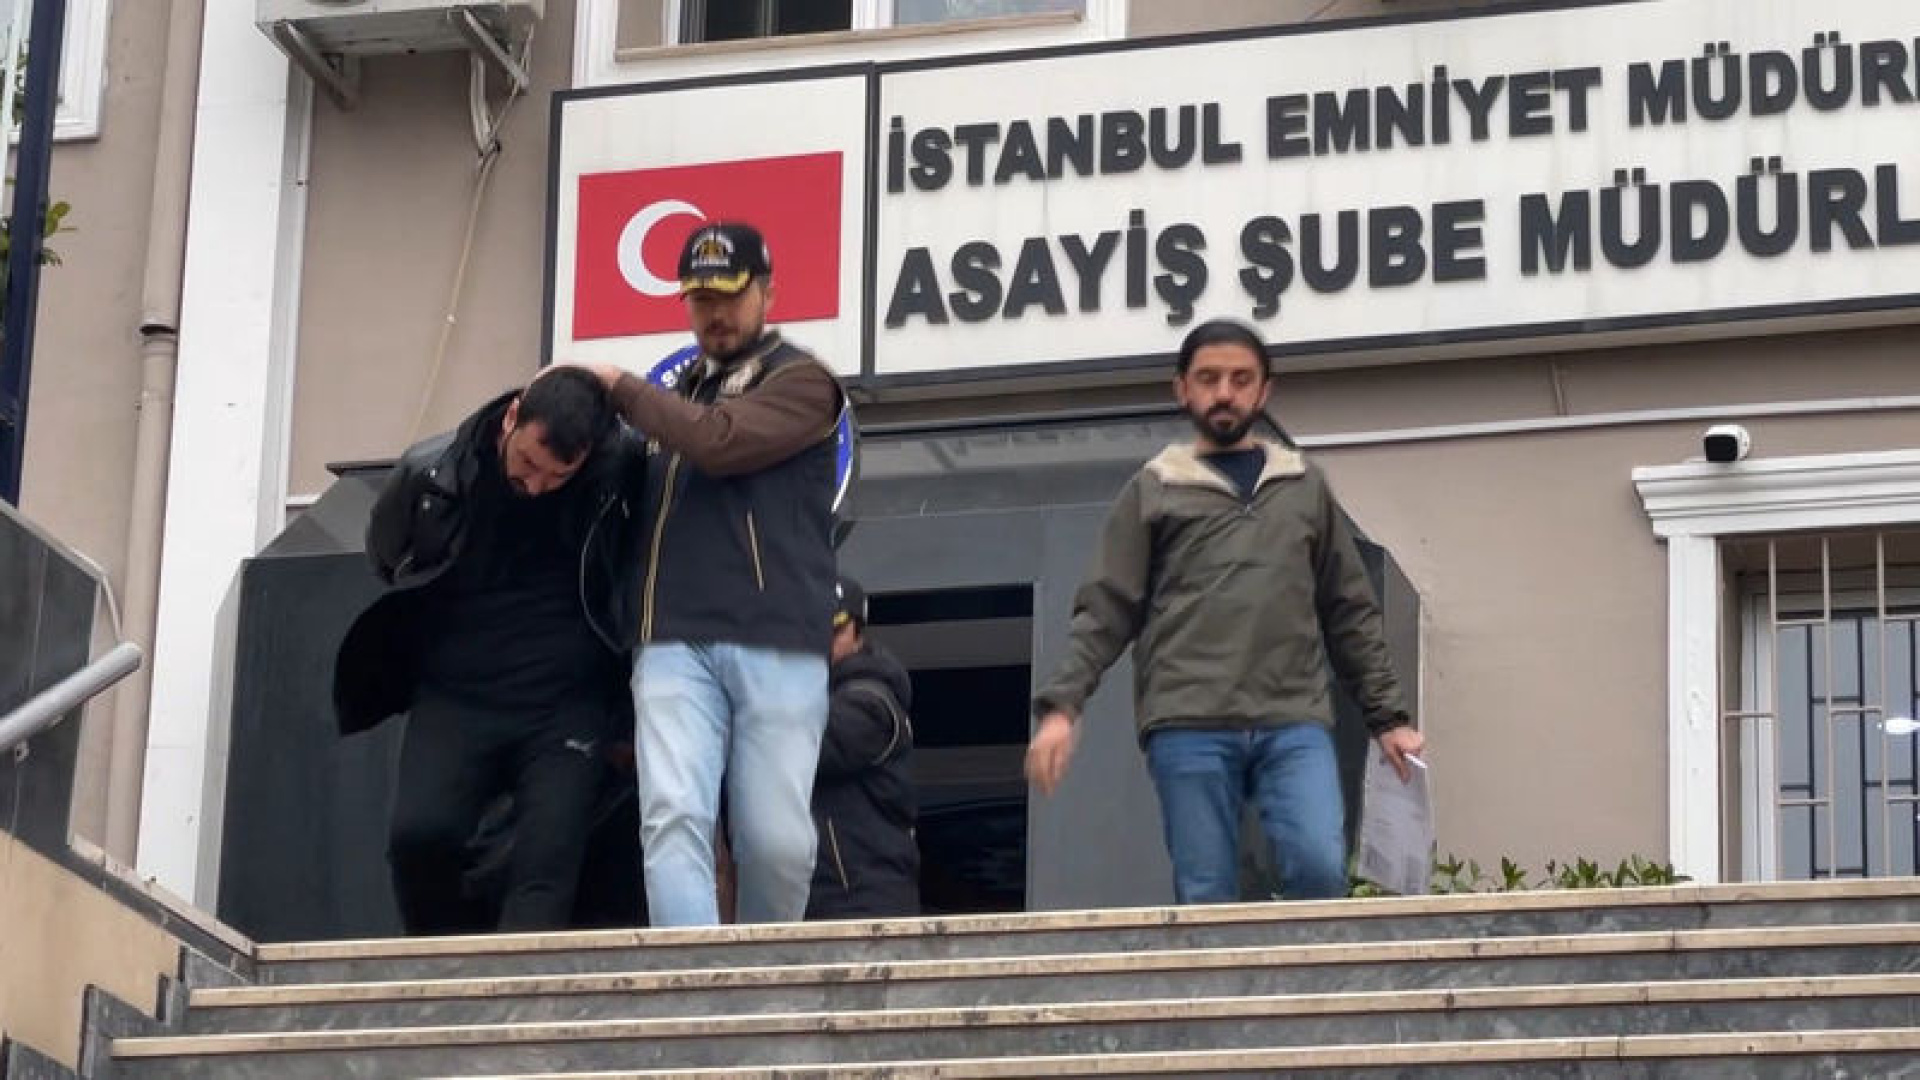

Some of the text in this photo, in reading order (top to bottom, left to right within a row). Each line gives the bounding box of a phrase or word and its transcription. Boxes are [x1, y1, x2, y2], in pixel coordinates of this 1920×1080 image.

[886, 30, 1920, 195] İSTANBUL EMNİYET MÜDÜR
[885, 155, 1920, 328] ASAYİŞ ŞUBE MÜDÜRL
